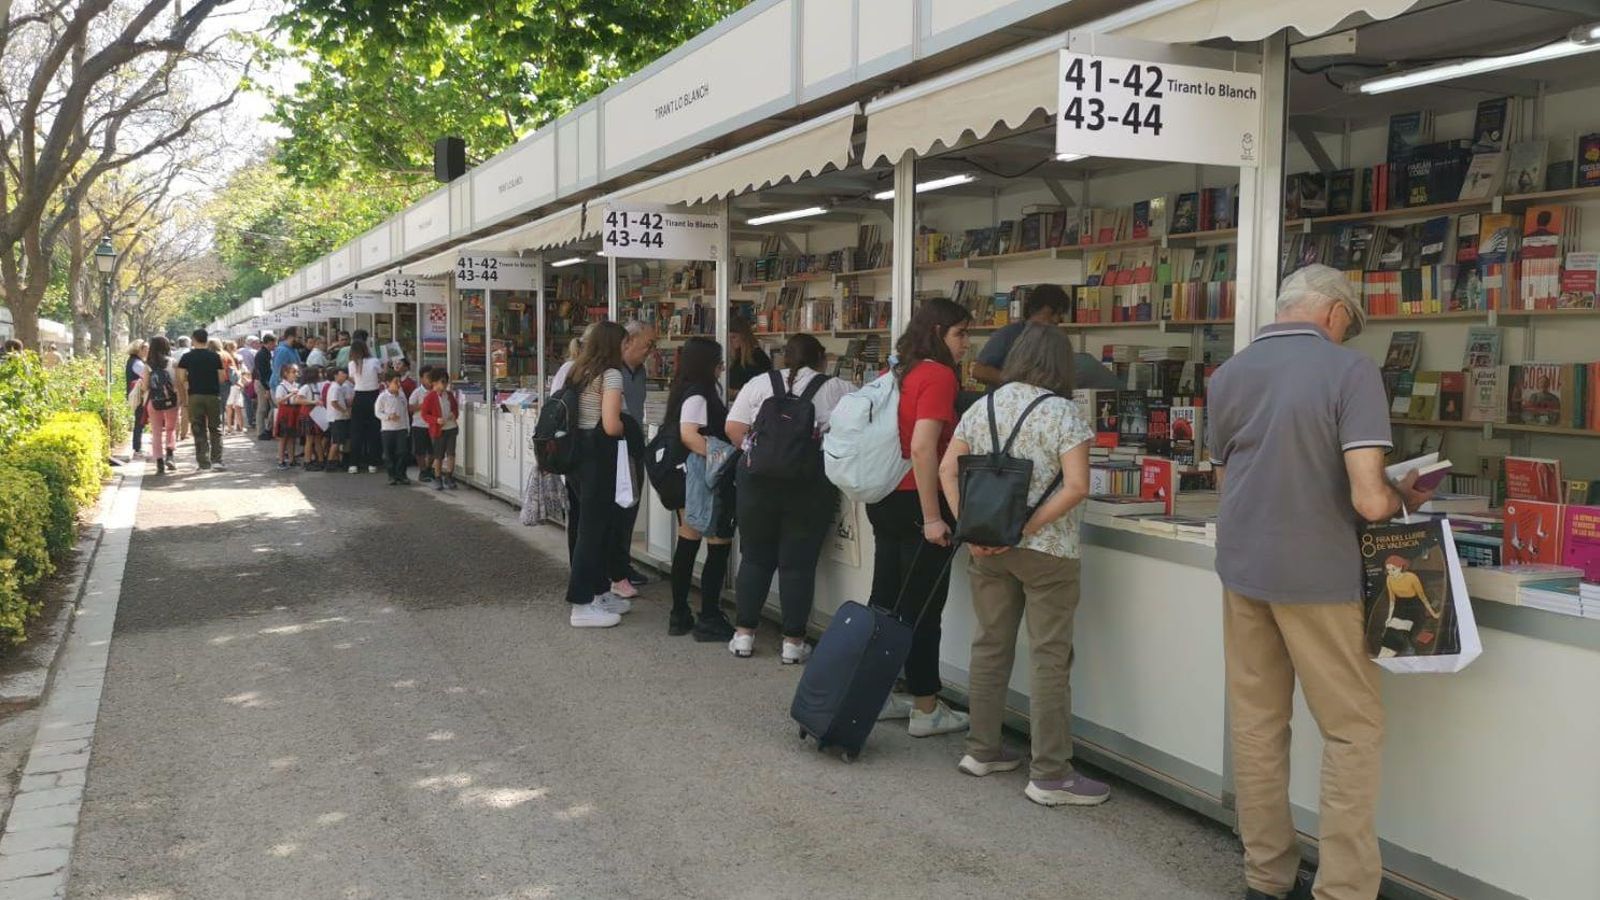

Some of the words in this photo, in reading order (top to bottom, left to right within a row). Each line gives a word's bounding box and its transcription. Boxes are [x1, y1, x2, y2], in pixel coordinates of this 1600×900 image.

[1065, 58, 1164, 99] 41-42
[1167, 79, 1202, 95] Tirant
[1204, 82, 1216, 96] lo
[1219, 84, 1257, 100] Blanch
[654, 101, 674, 119] TIRANT
[1064, 96, 1163, 136] 43-44
[606, 211, 663, 230] 41-42
[665, 220, 686, 228] Tirant
[687, 220, 694, 228] lo
[694, 221, 719, 229] Blanch
[606, 230, 664, 248] 43-44
[457, 257, 498, 269] 41-42
[384, 280, 416, 289] 41-42
[457, 270, 498, 282] 43-44
[384, 288, 417, 297] 43-44
